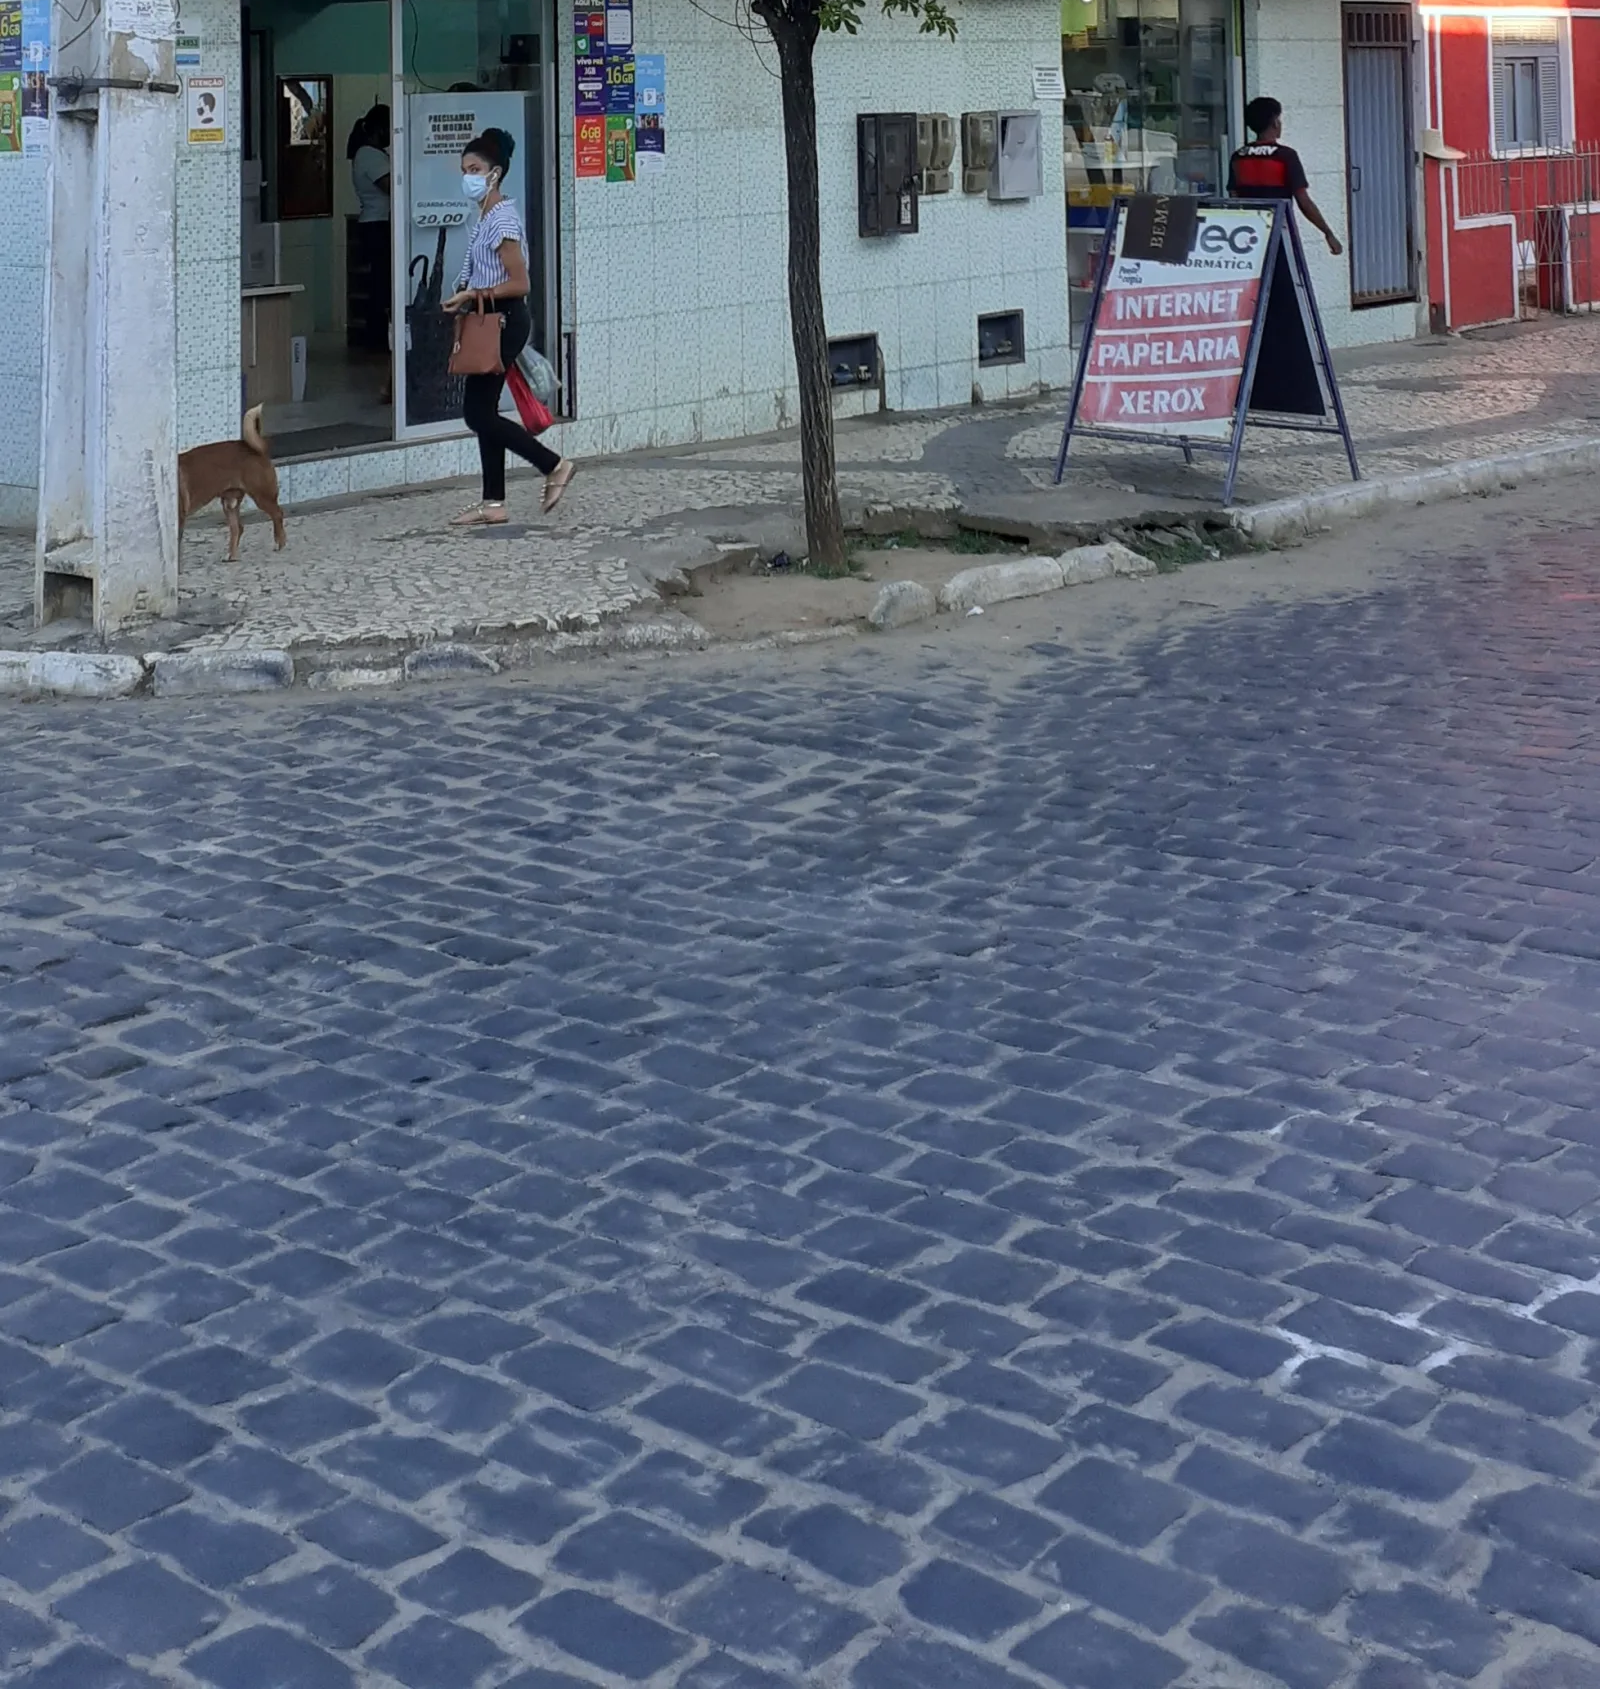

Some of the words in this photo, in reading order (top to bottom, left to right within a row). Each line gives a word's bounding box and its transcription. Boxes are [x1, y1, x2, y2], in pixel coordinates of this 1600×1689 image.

[189, 78, 223, 88] ATENÇÃO
[443, 123, 472, 132] MOEDAS
[417, 213, 464, 224] 20,00
[1116, 288, 1243, 320] INTERNET
[1099, 336, 1240, 368] PAPELARIA
[1119, 387, 1206, 415] XEROX
